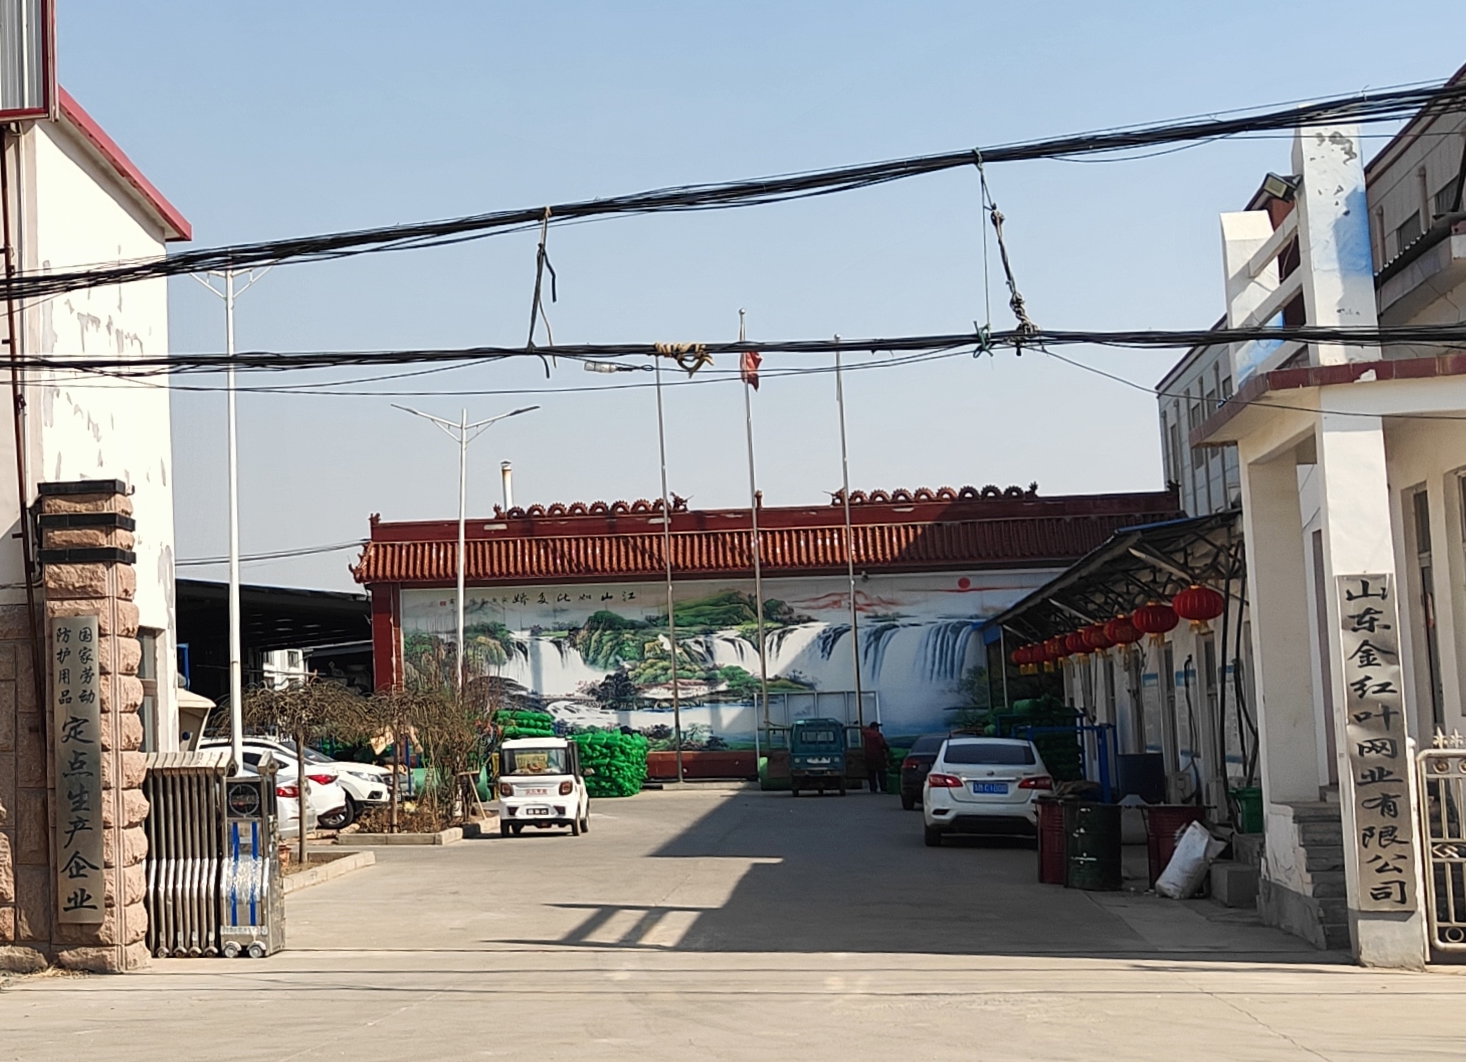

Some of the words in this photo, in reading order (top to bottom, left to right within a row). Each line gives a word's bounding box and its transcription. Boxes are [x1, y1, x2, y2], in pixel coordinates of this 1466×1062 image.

[56, 626, 73, 705] 防护用品
[78, 626, 96, 705] 国家劳动
[1345, 578, 1410, 905] 山东金红叶网业有限公司
[60, 715, 101, 913] 定点生产企业
